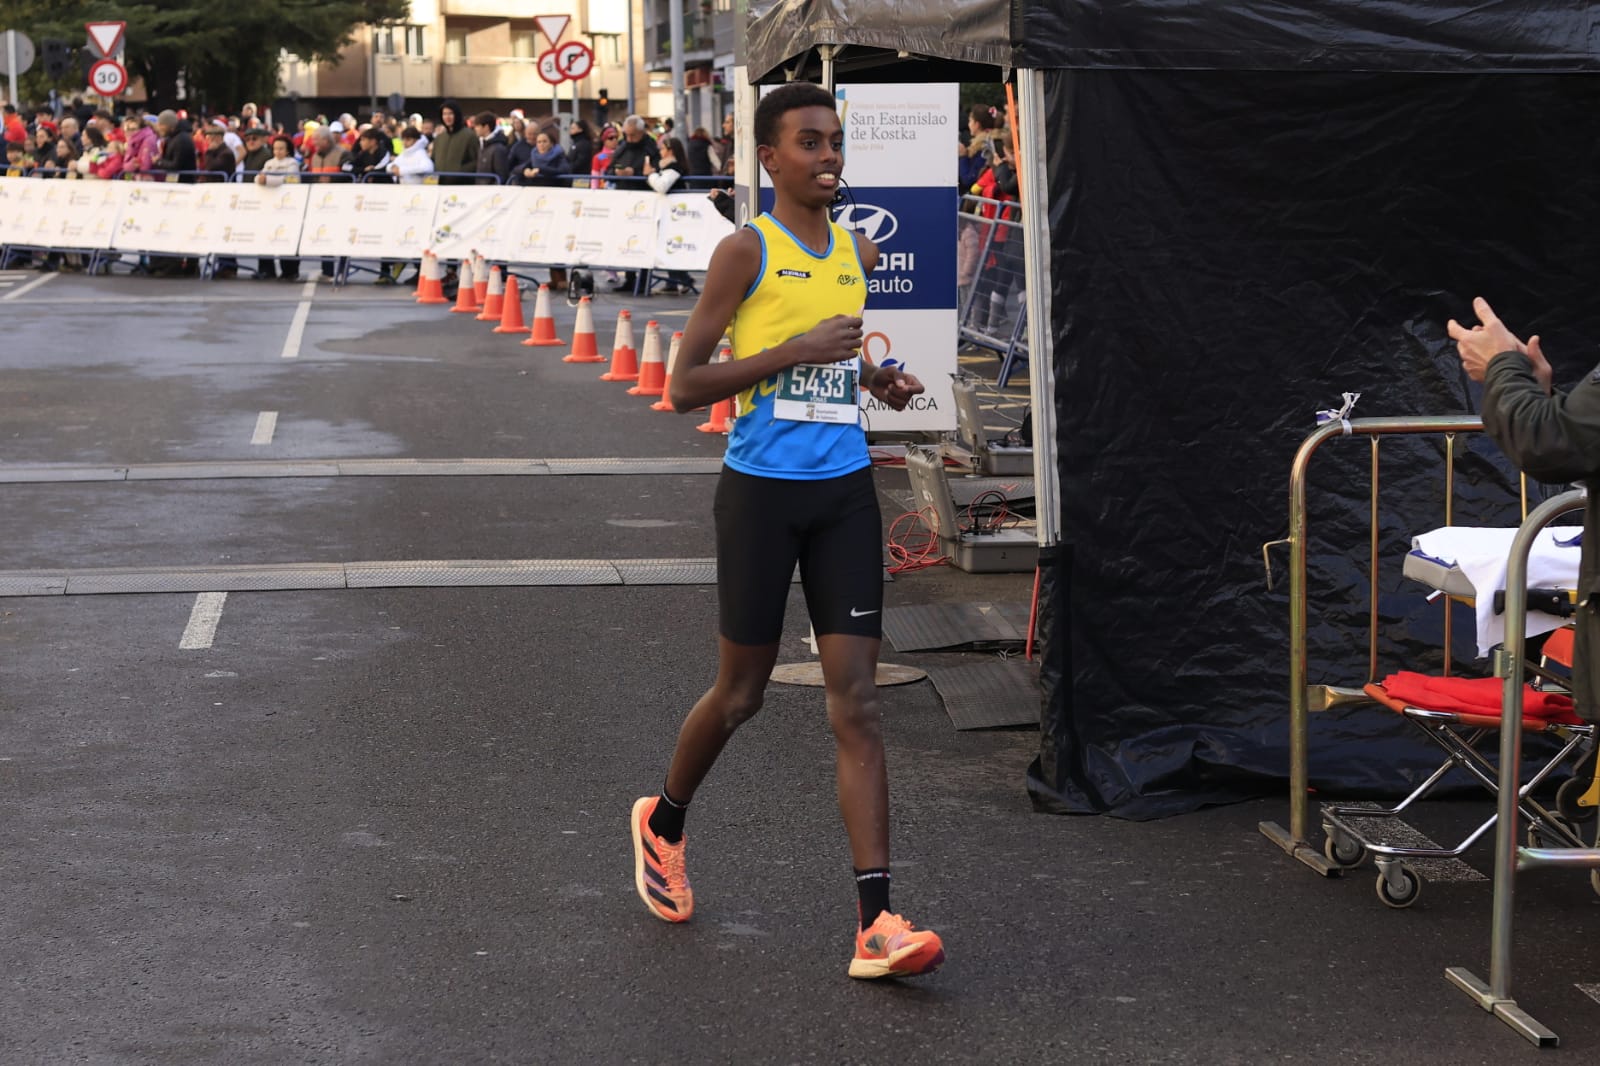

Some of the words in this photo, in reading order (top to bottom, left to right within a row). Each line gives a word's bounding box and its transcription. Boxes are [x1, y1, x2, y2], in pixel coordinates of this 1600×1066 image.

[97, 71, 117, 84] 30
[850, 112, 875, 126] San
[879, 112, 948, 126] Estanislao
[850, 126, 867, 140] de
[870, 126, 917, 140] Kostka
[872, 252, 915, 271] DAI
[867, 275, 914, 294] auto
[790, 365, 845, 398] 5433
